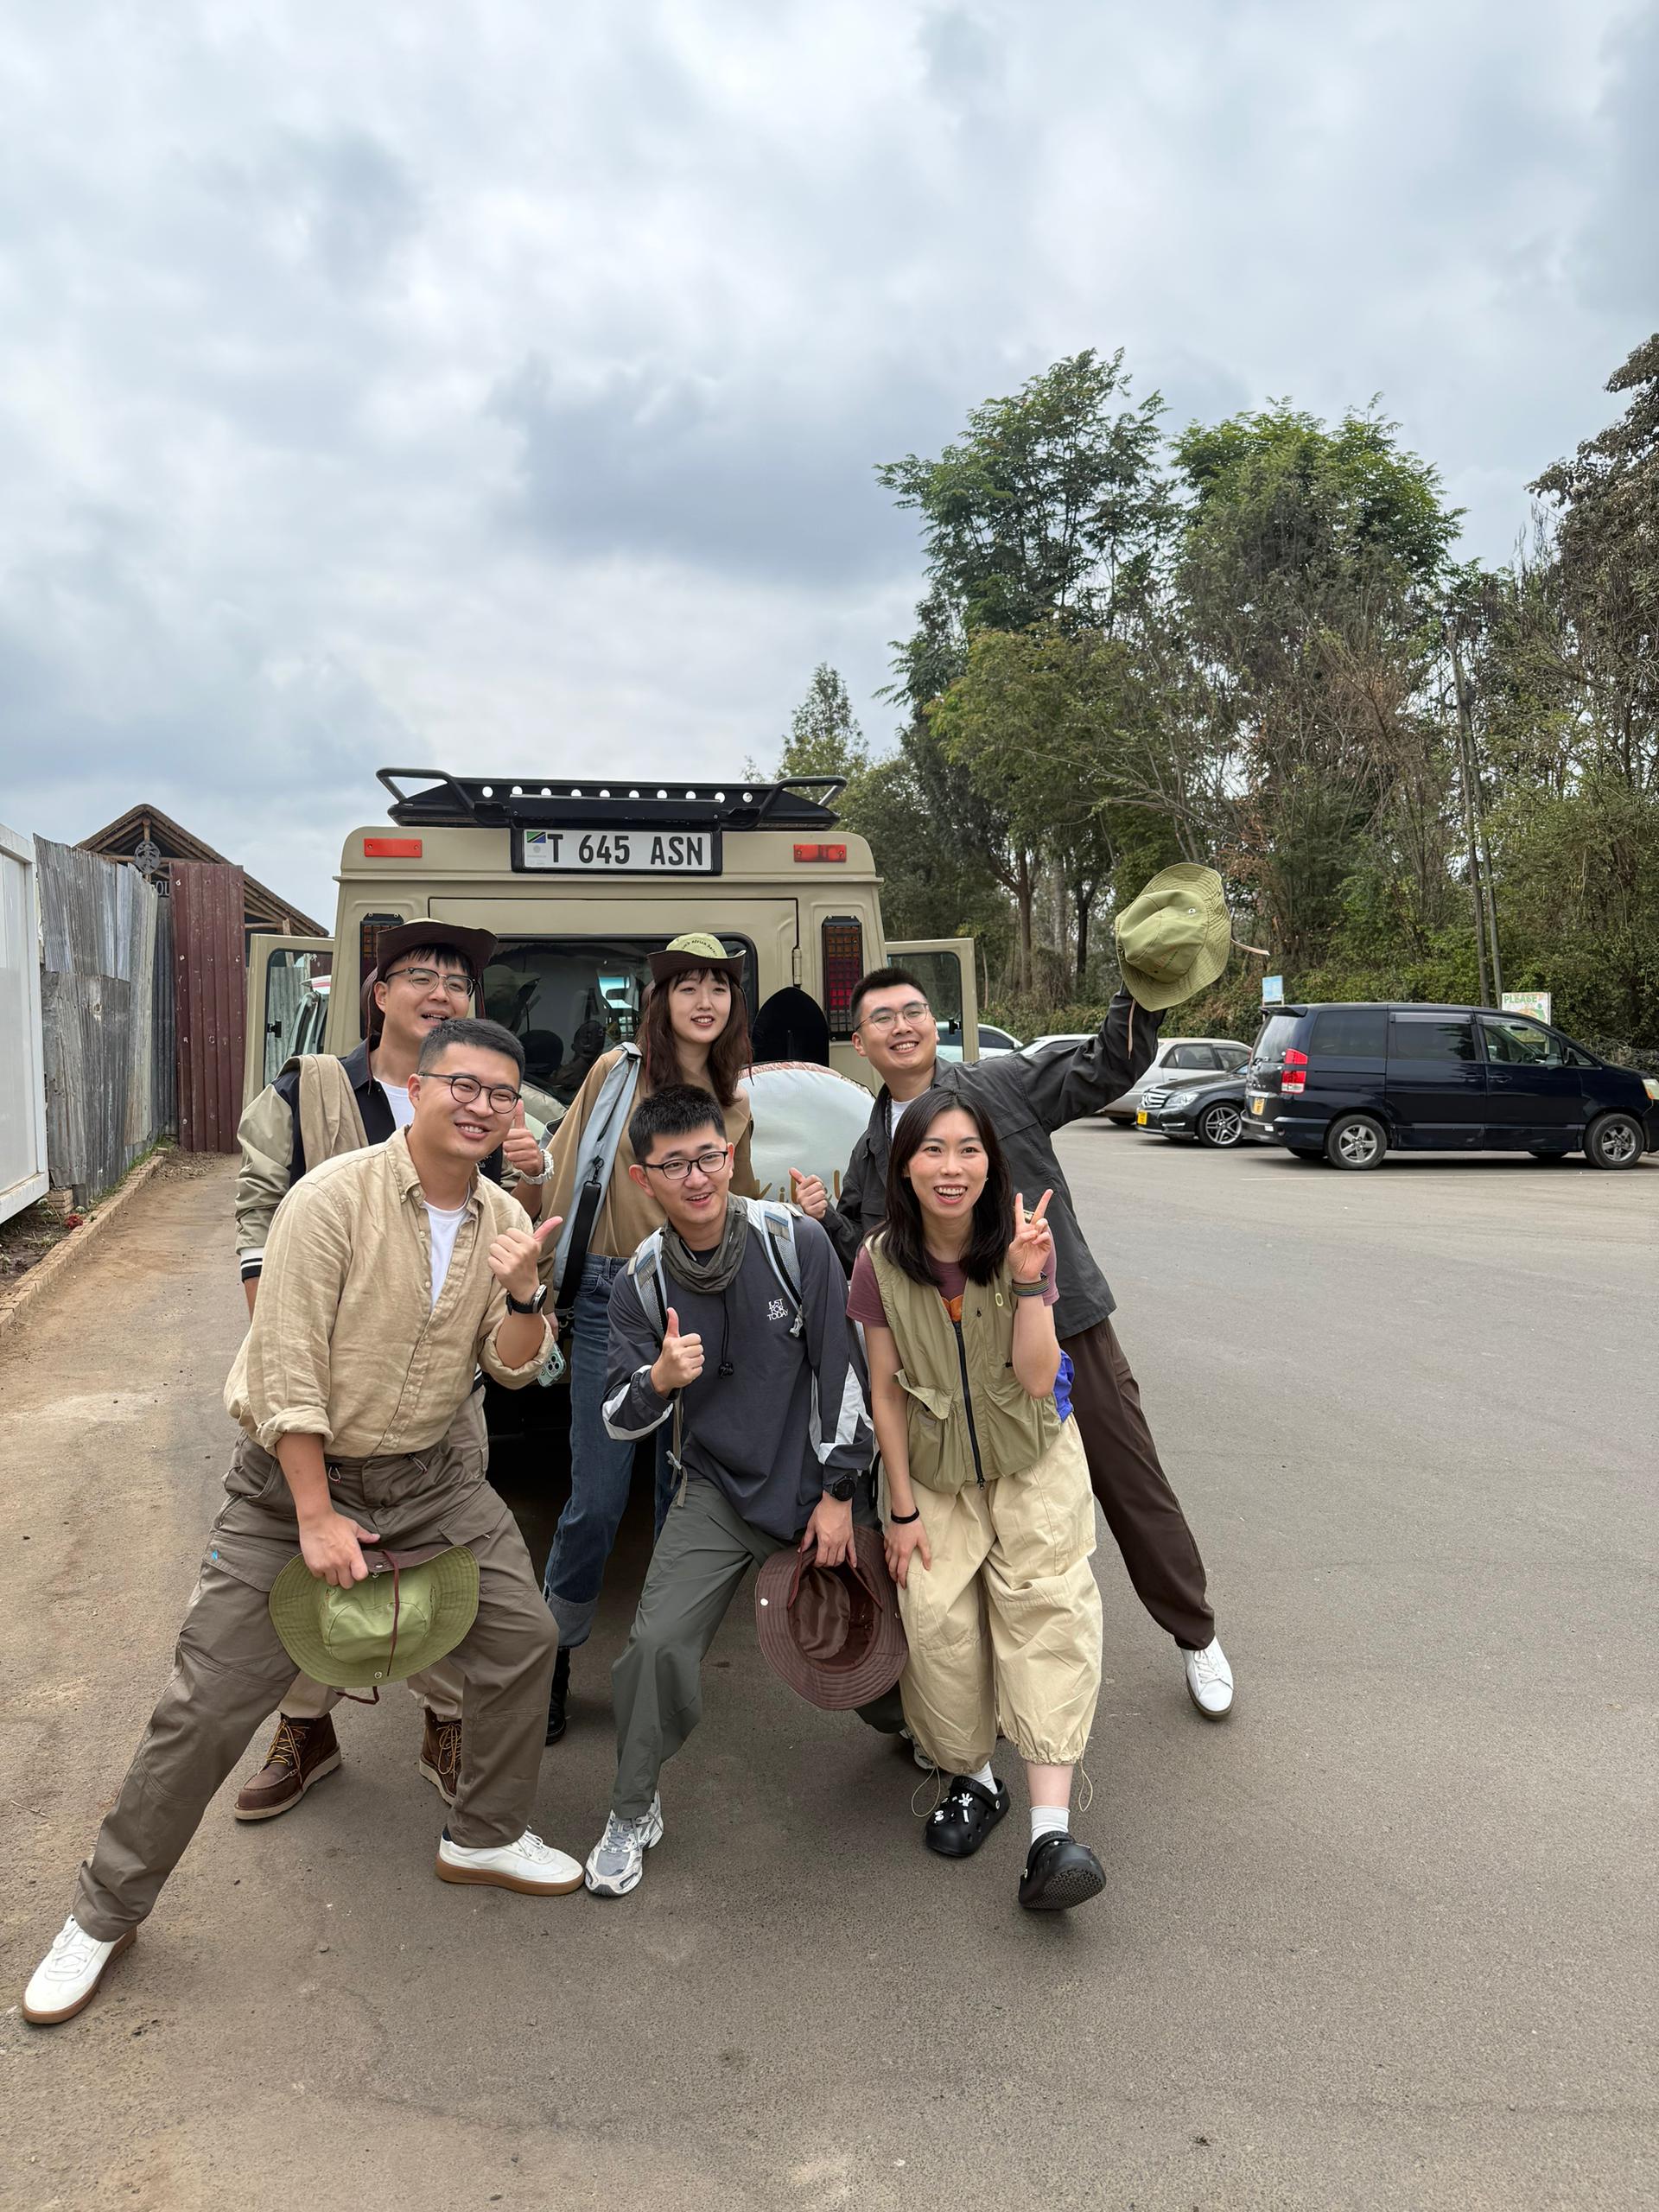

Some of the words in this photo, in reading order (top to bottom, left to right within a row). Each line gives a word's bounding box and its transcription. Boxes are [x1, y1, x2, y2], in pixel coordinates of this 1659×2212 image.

[548, 834, 563, 863] T
[578, 835, 630, 865] 645
[650, 836, 703, 866] ASN
[1503, 995, 1537, 1003] PLEASE
[768, 1298, 783, 1308] JUST
[769, 1305, 784, 1314] FOR
[766, 1309, 788, 1321] TODAY
